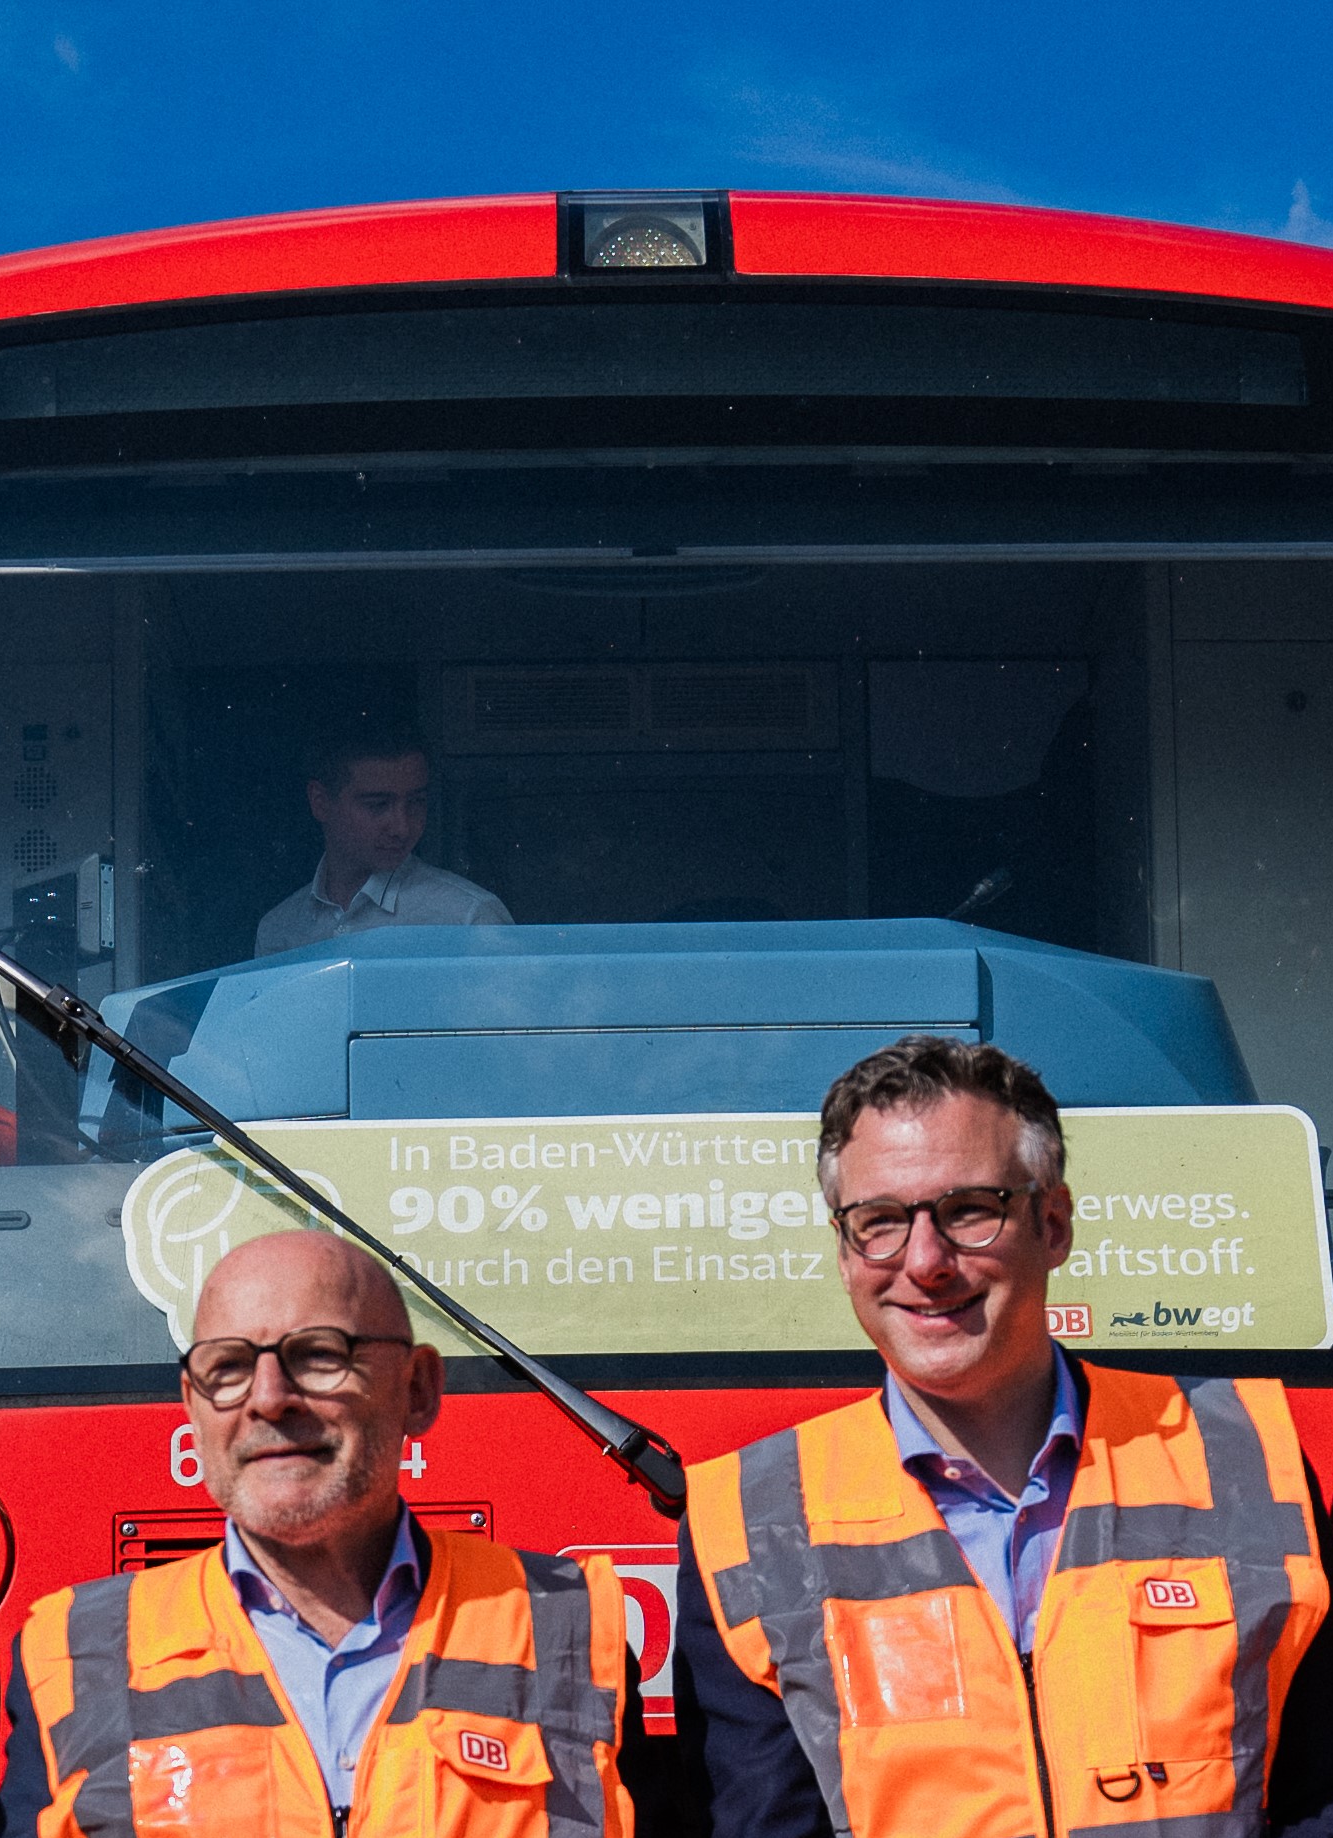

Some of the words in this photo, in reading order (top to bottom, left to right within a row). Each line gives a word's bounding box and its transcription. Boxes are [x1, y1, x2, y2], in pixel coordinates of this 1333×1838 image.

[390, 1136, 430, 1172] In
[449, 1130, 819, 1171] Baden-Württem
[388, 1184, 549, 1235] 90%
[1070, 1193, 1251, 1230] erwegs.
[546, 1247, 634, 1284] den
[653, 1246, 825, 1283] Einsatz
[1053, 1237, 1256, 1277] aftstoff.
[1046, 1310, 1086, 1334] DB
[1153, 1301, 1255, 1333] bwegt
[1150, 1584, 1190, 1603] DB
[467, 1736, 503, 1766] DB
